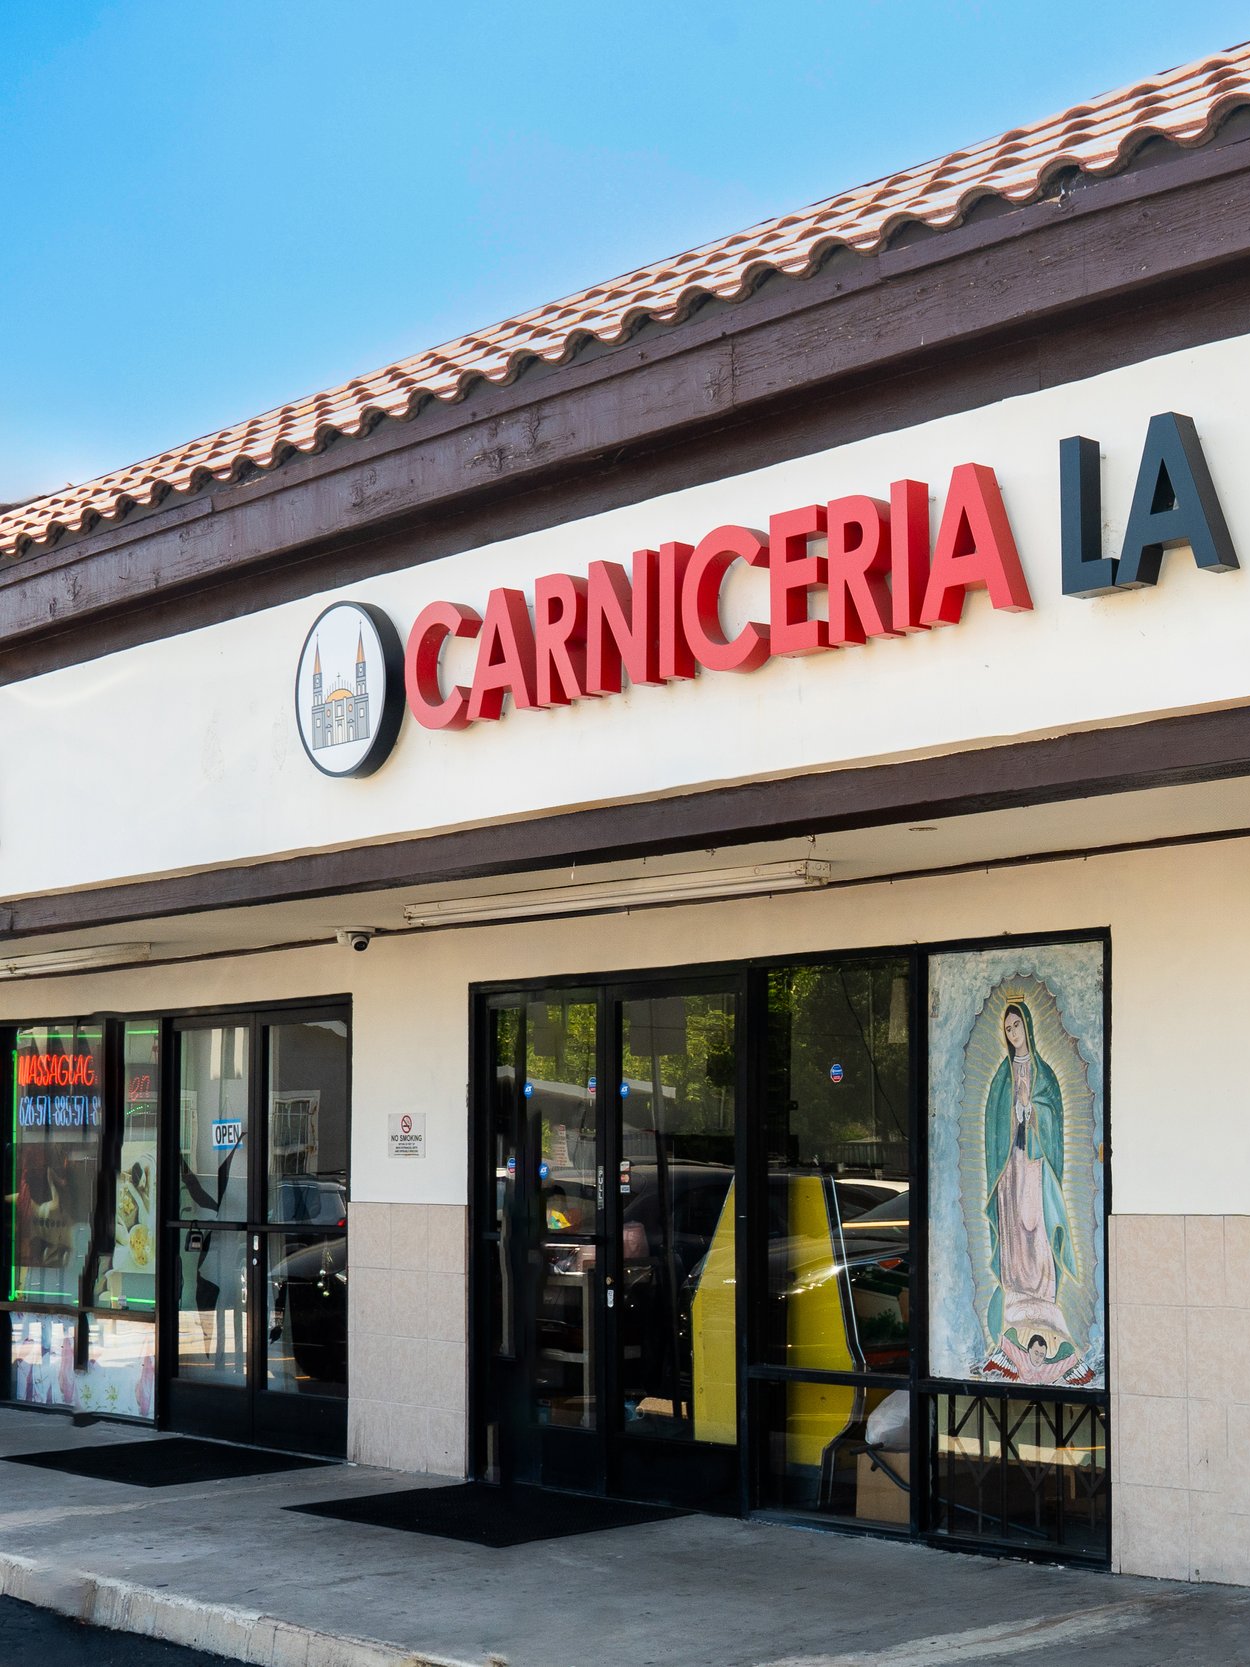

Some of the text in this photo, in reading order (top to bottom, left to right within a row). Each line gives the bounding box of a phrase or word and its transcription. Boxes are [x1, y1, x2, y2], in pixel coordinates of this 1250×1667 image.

[404, 462, 1033, 731] CARNICERIA
[1059, 411, 1240, 600] LA
[215, 1124, 240, 1144] OPEN
[400, 1134, 423, 1142] SMOKING
